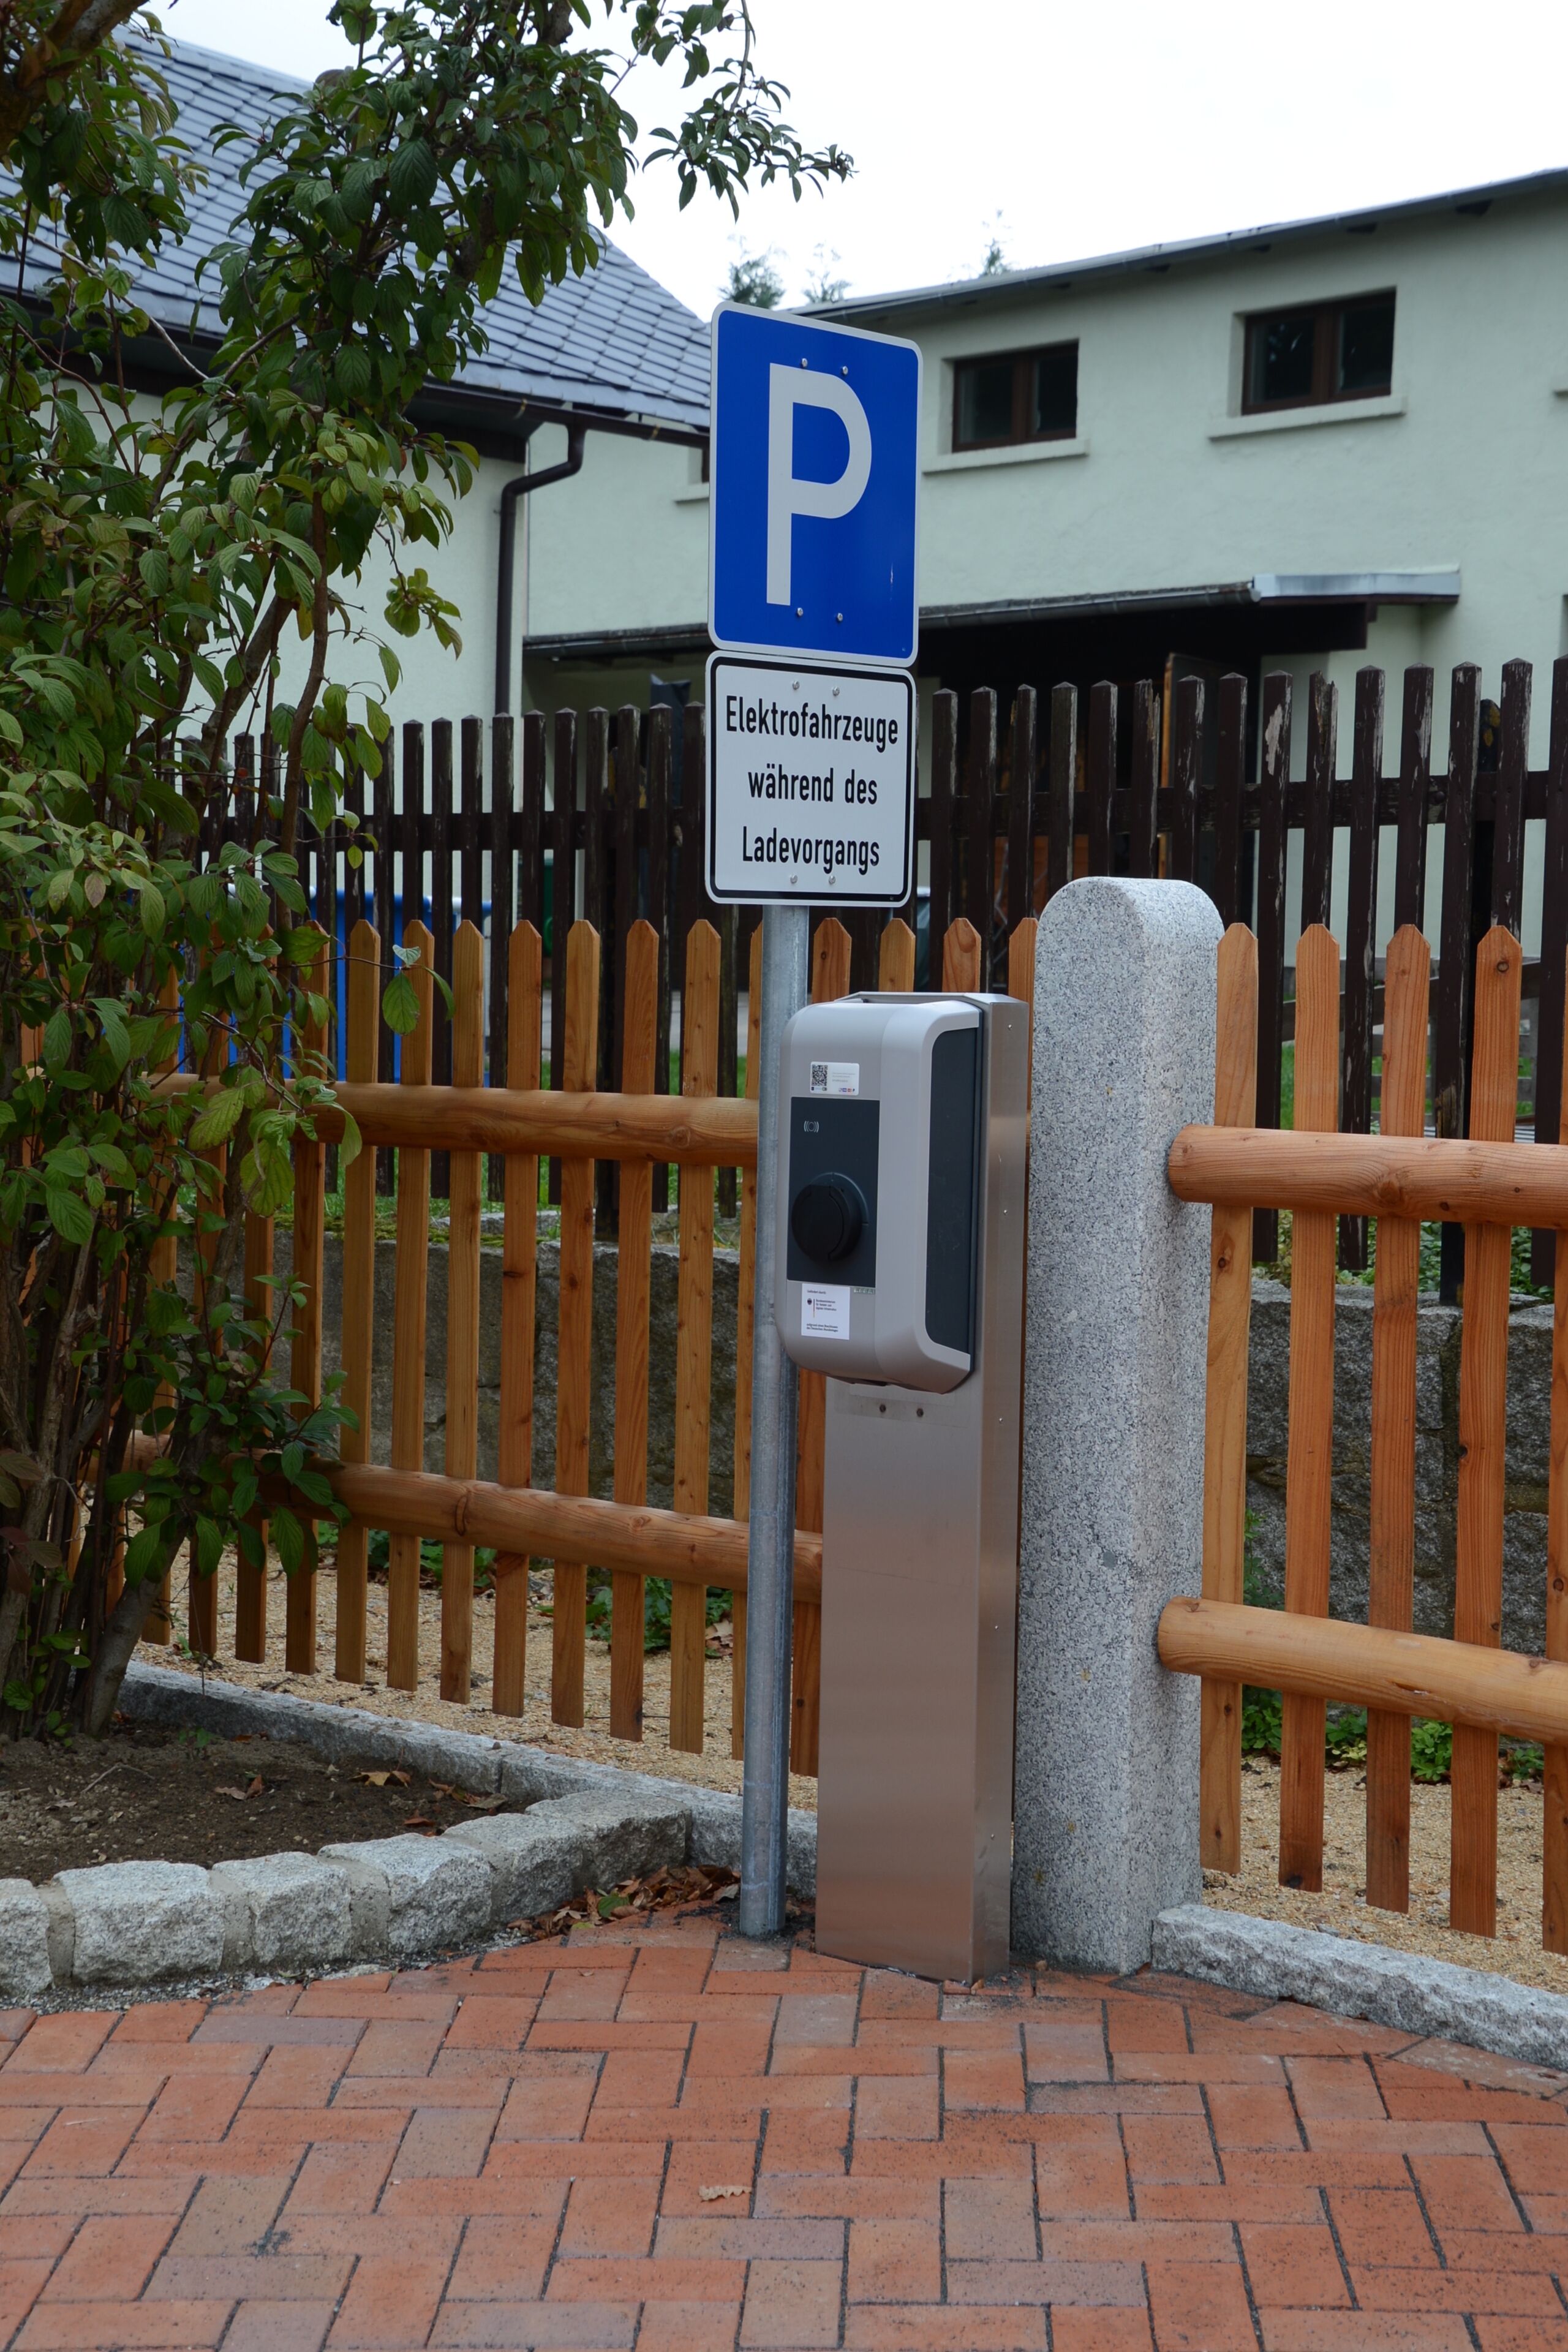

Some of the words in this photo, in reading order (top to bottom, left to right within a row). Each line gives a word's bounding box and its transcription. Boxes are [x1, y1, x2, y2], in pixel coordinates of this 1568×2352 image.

[766, 363, 872, 606] P
[726, 695, 899, 753] Elektrofahrzeuge
[747, 763, 834, 803] während
[845, 769, 878, 805] des
[742, 826, 880, 876] Ladevorgangs
